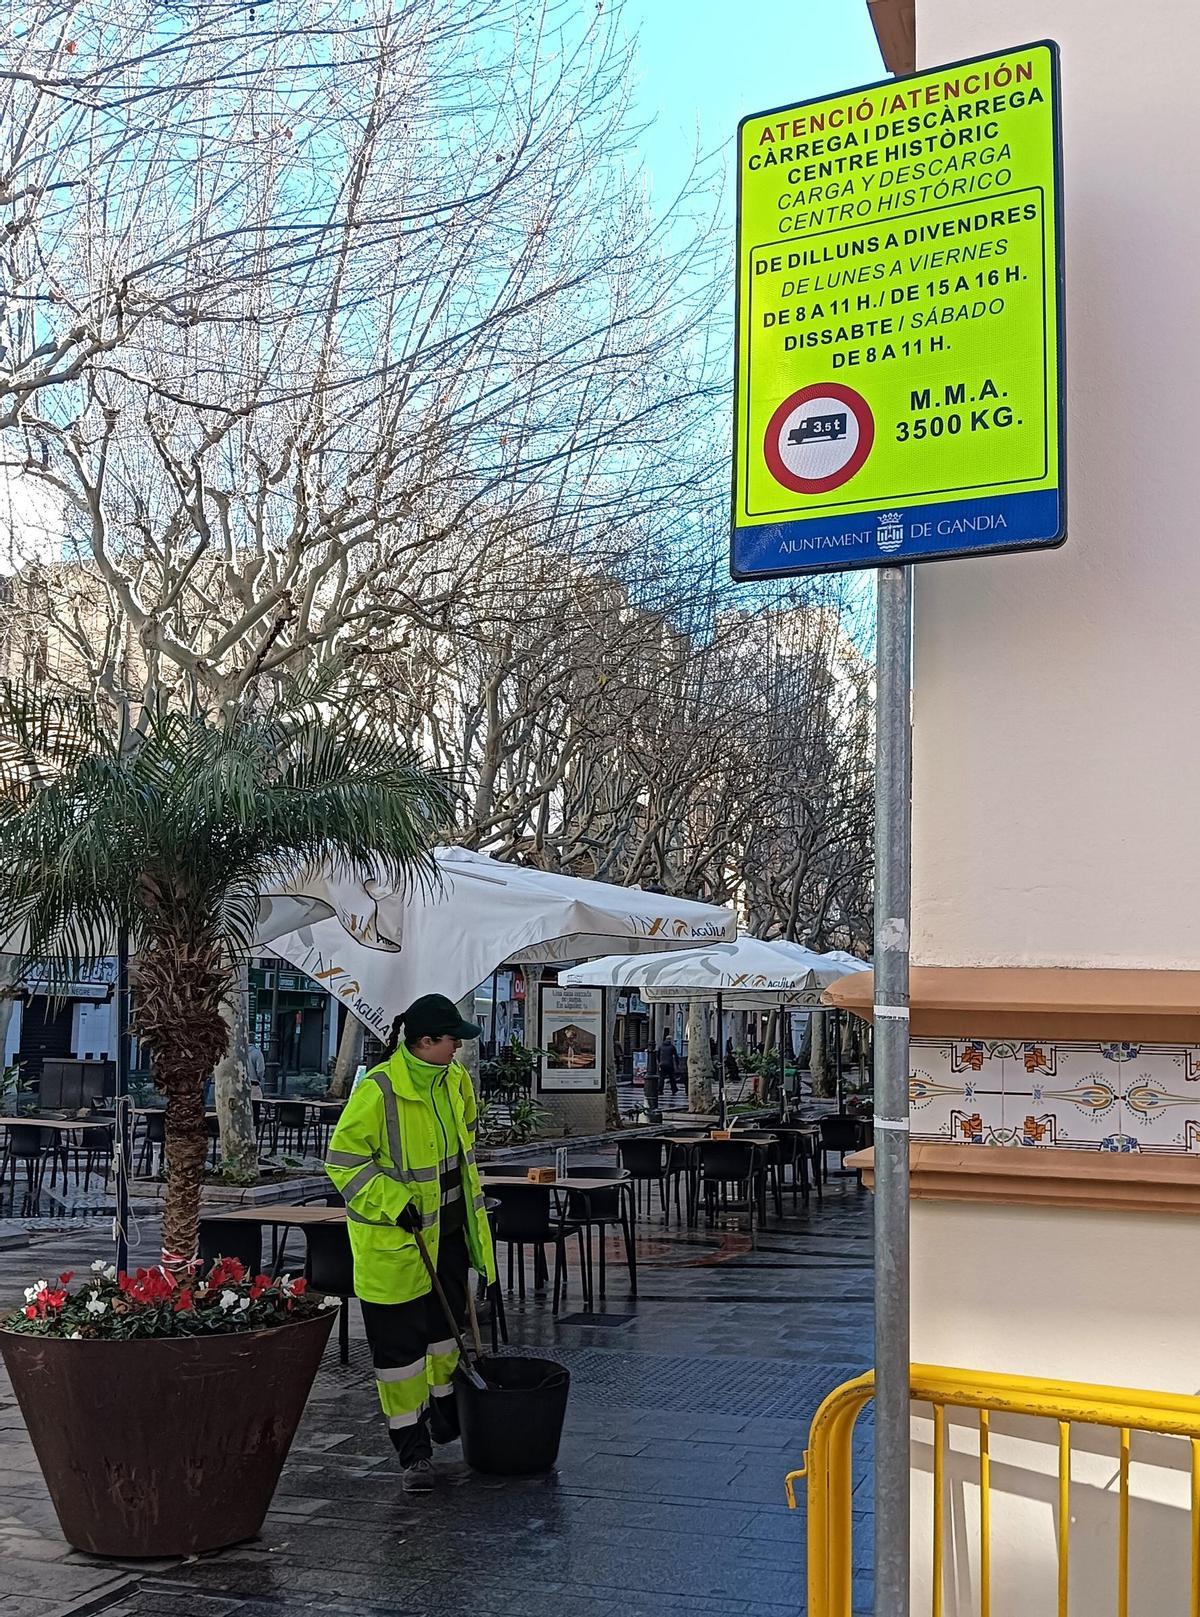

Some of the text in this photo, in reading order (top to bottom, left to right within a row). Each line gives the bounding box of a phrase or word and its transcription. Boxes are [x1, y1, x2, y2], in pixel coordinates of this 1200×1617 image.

[749, 88, 1043, 170] CÀRREGA I DESCÀRREGA
[760, 98, 873, 145] ATENCIÓ
[778, 144, 1010, 209] CARGA Y DESCARGA
[788, 122, 998, 184] CENTRE HISTÒRIC
[779, 169, 1011, 232] CENTRO HISTÓRICO
[756, 204, 1036, 275] DE DILLUNS A DIVENDRES
[782, 239, 1008, 297] DE LUNES A VIERNES
[764, 310, 789, 327] DE
[796, 307, 805, 321] 8
[811, 304, 824, 319] A
[830, 298, 848, 314] 11
[892, 285, 919, 304] DE
[927, 280, 949, 296] 15
[955, 276, 969, 292] A
[976, 270, 998, 287] 16
[1006, 266, 1026, 282] H.
[785, 319, 892, 351] DISSABTE
[911, 298, 1004, 328] SÁBADO
[833, 336, 950, 368] DE 8 A 11 H.
[911, 380, 1007, 410] M.M.A.
[896, 407, 1022, 442] 3500 KG.
[779, 513, 1007, 553] AJUNTAMENT DE GANDIA
